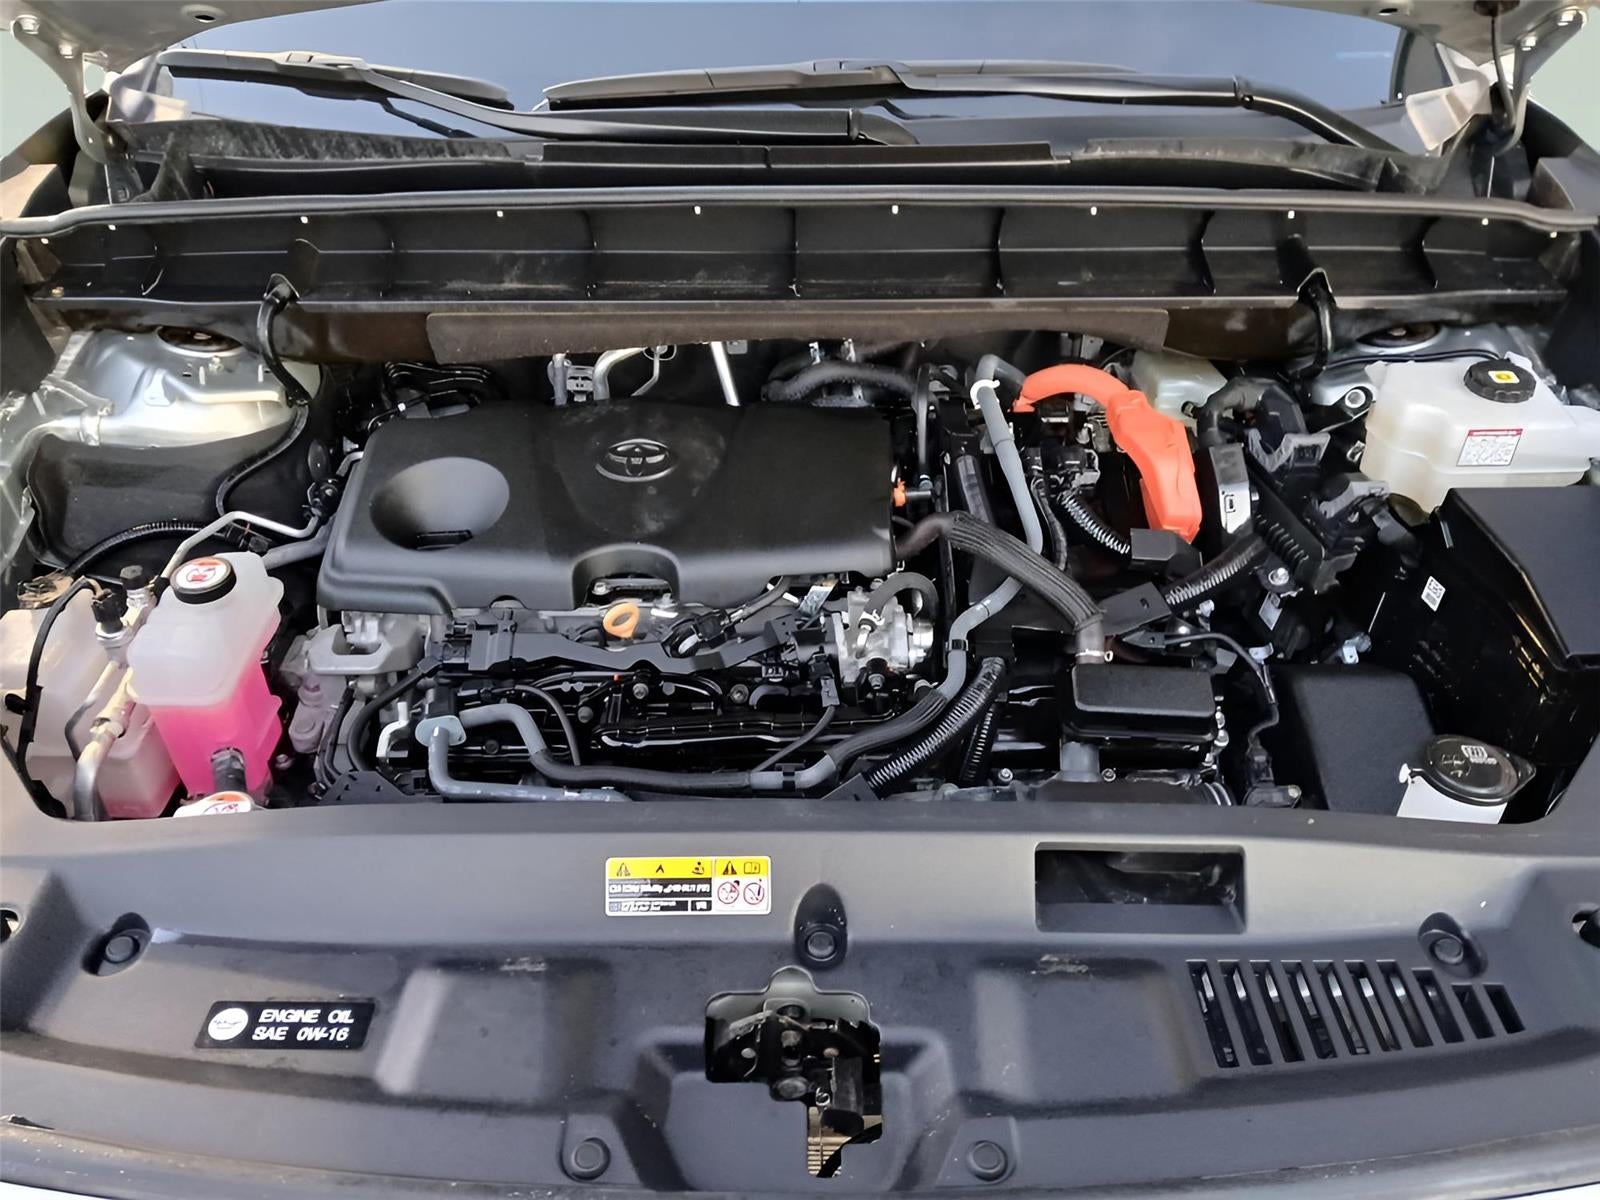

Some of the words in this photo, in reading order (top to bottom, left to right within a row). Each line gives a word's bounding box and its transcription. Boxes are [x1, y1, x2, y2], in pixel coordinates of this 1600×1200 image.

[258, 1009, 321, 1023] ENGINE
[327, 1010, 354, 1024] OIL
[252, 1026, 289, 1041] SAE
[296, 1027, 350, 1042] 0W-16
